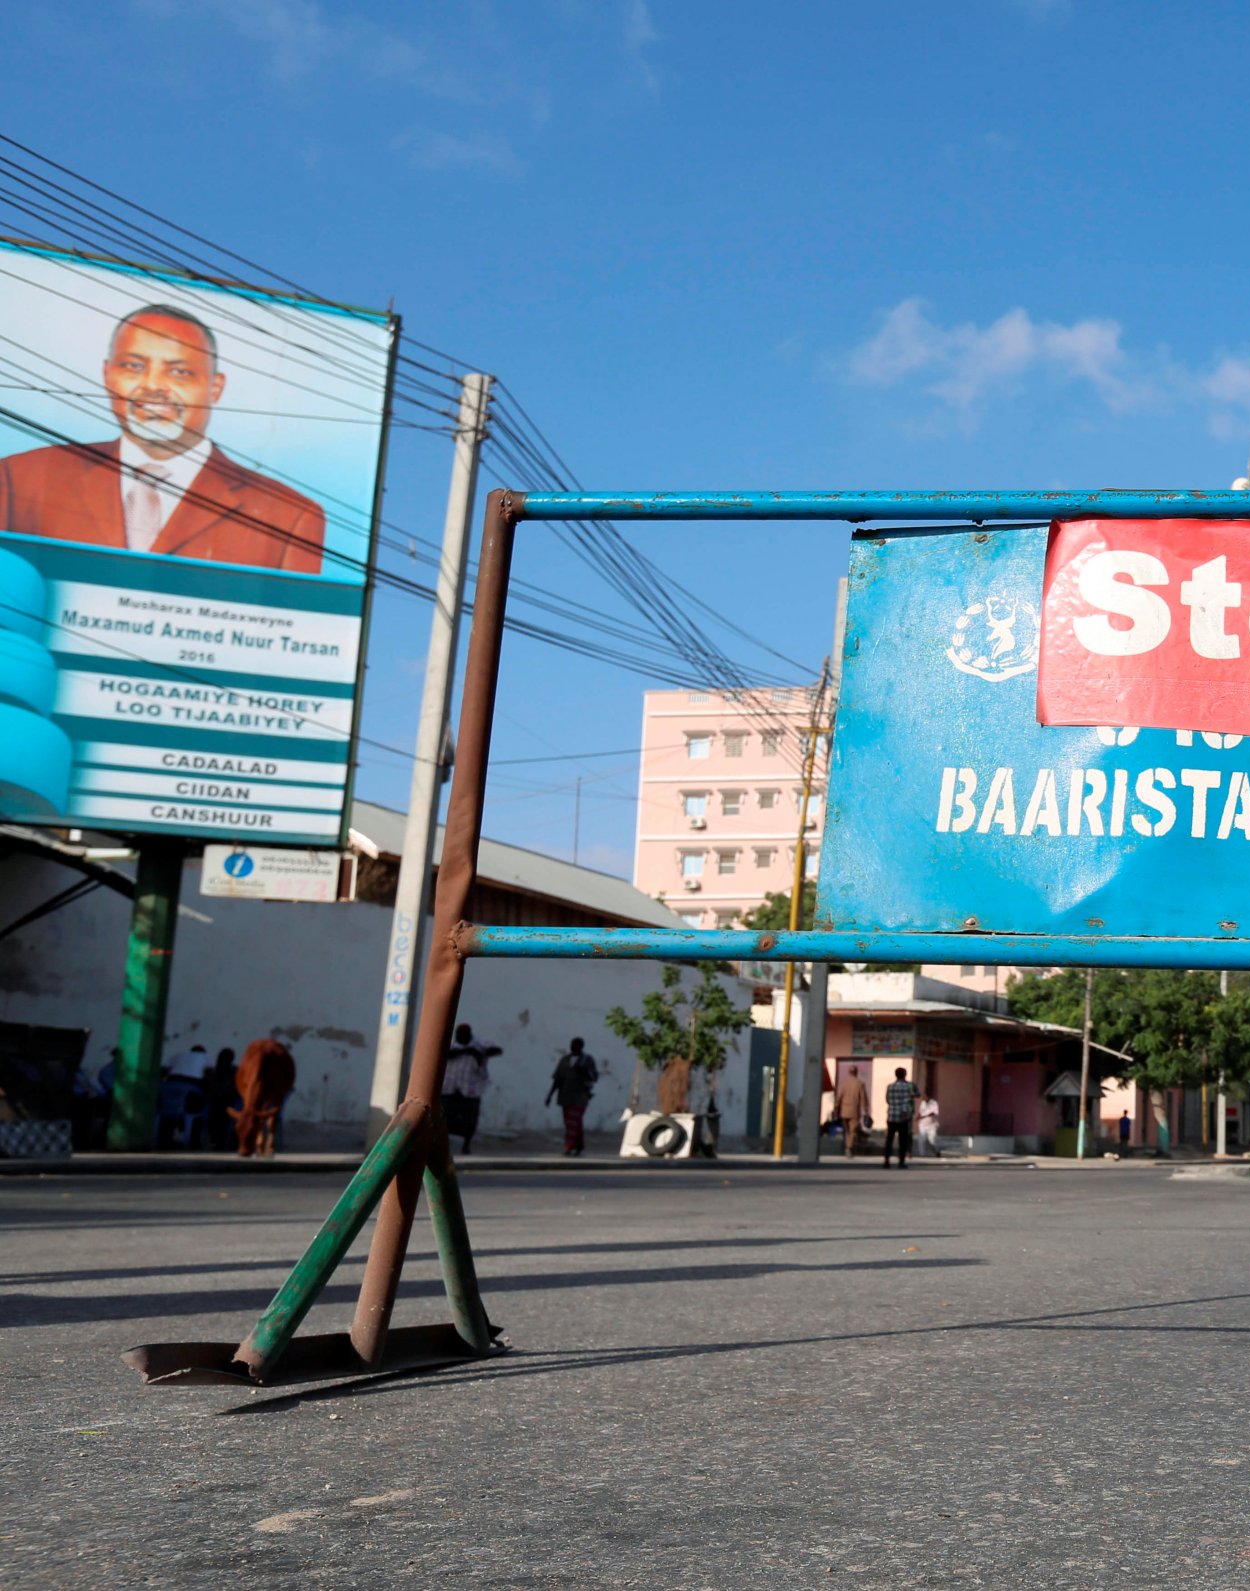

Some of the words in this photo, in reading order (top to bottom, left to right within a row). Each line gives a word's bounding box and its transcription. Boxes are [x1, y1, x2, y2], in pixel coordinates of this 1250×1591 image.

[117, 596, 193, 616] Musharax
[197, 605, 295, 629] Madaxweyne
[60, 608, 155, 637] Maxamud
[160, 621, 226, 646] Axmed
[230, 630, 274, 652] Nuur
[280, 636, 341, 658] Tarsan
[178, 649, 217, 665] 2016
[98, 678, 240, 707] HOGAAMIYE
[248, 694, 324, 714] HOREY
[115, 701, 162, 718] LOO
[172, 707, 307, 732] TIJAABIYEY
[161, 752, 278, 776] CADAALAD
[175, 781, 251, 800] CIIDAN
[150, 804, 273, 828] CANSHUUR
